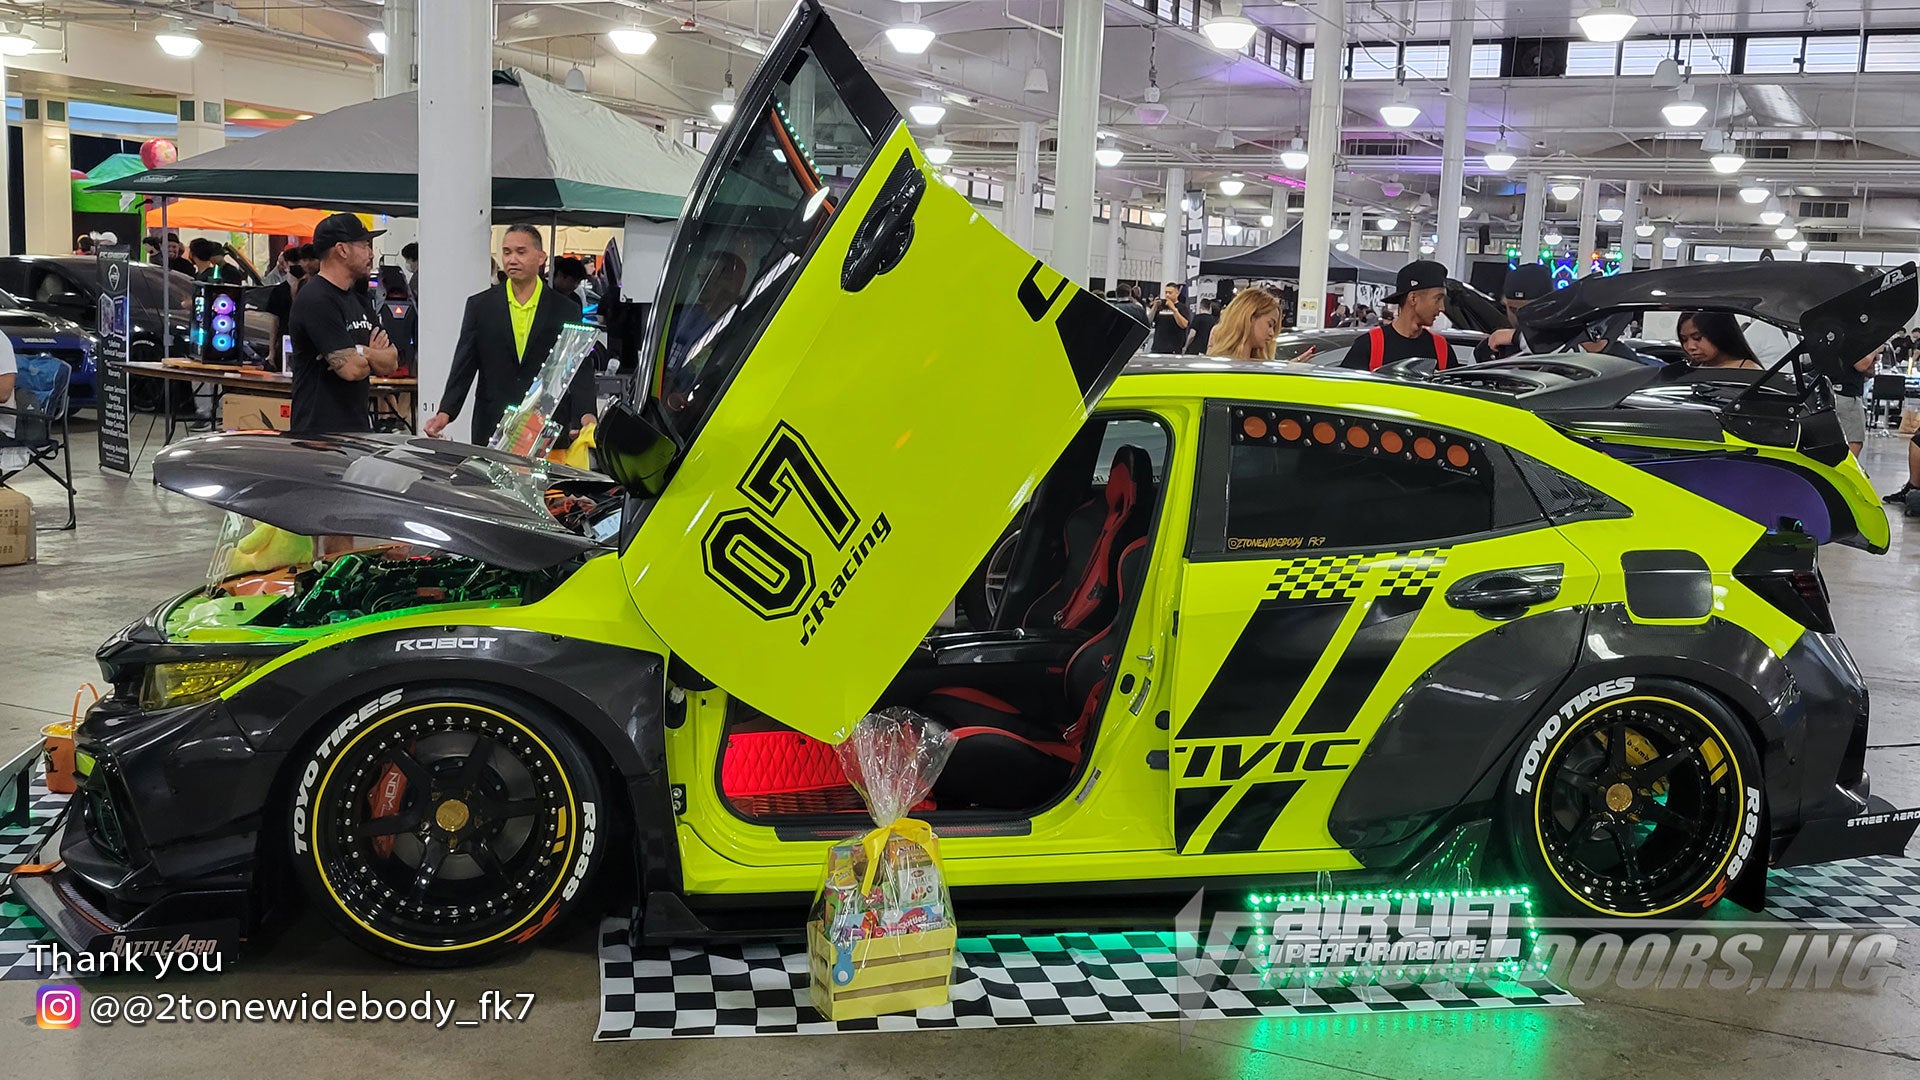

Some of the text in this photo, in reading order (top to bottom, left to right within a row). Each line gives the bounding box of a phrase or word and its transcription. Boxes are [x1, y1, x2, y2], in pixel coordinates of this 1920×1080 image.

[701, 419, 861, 622] 07
[395, 637, 498, 652] ROBOT
[293, 688, 404, 855] TOYO TIRES
[1175, 739, 1361, 781] IVIC
[1515, 676, 1636, 795] TOYO TIRES
[1847, 814, 1891, 828] STREET
